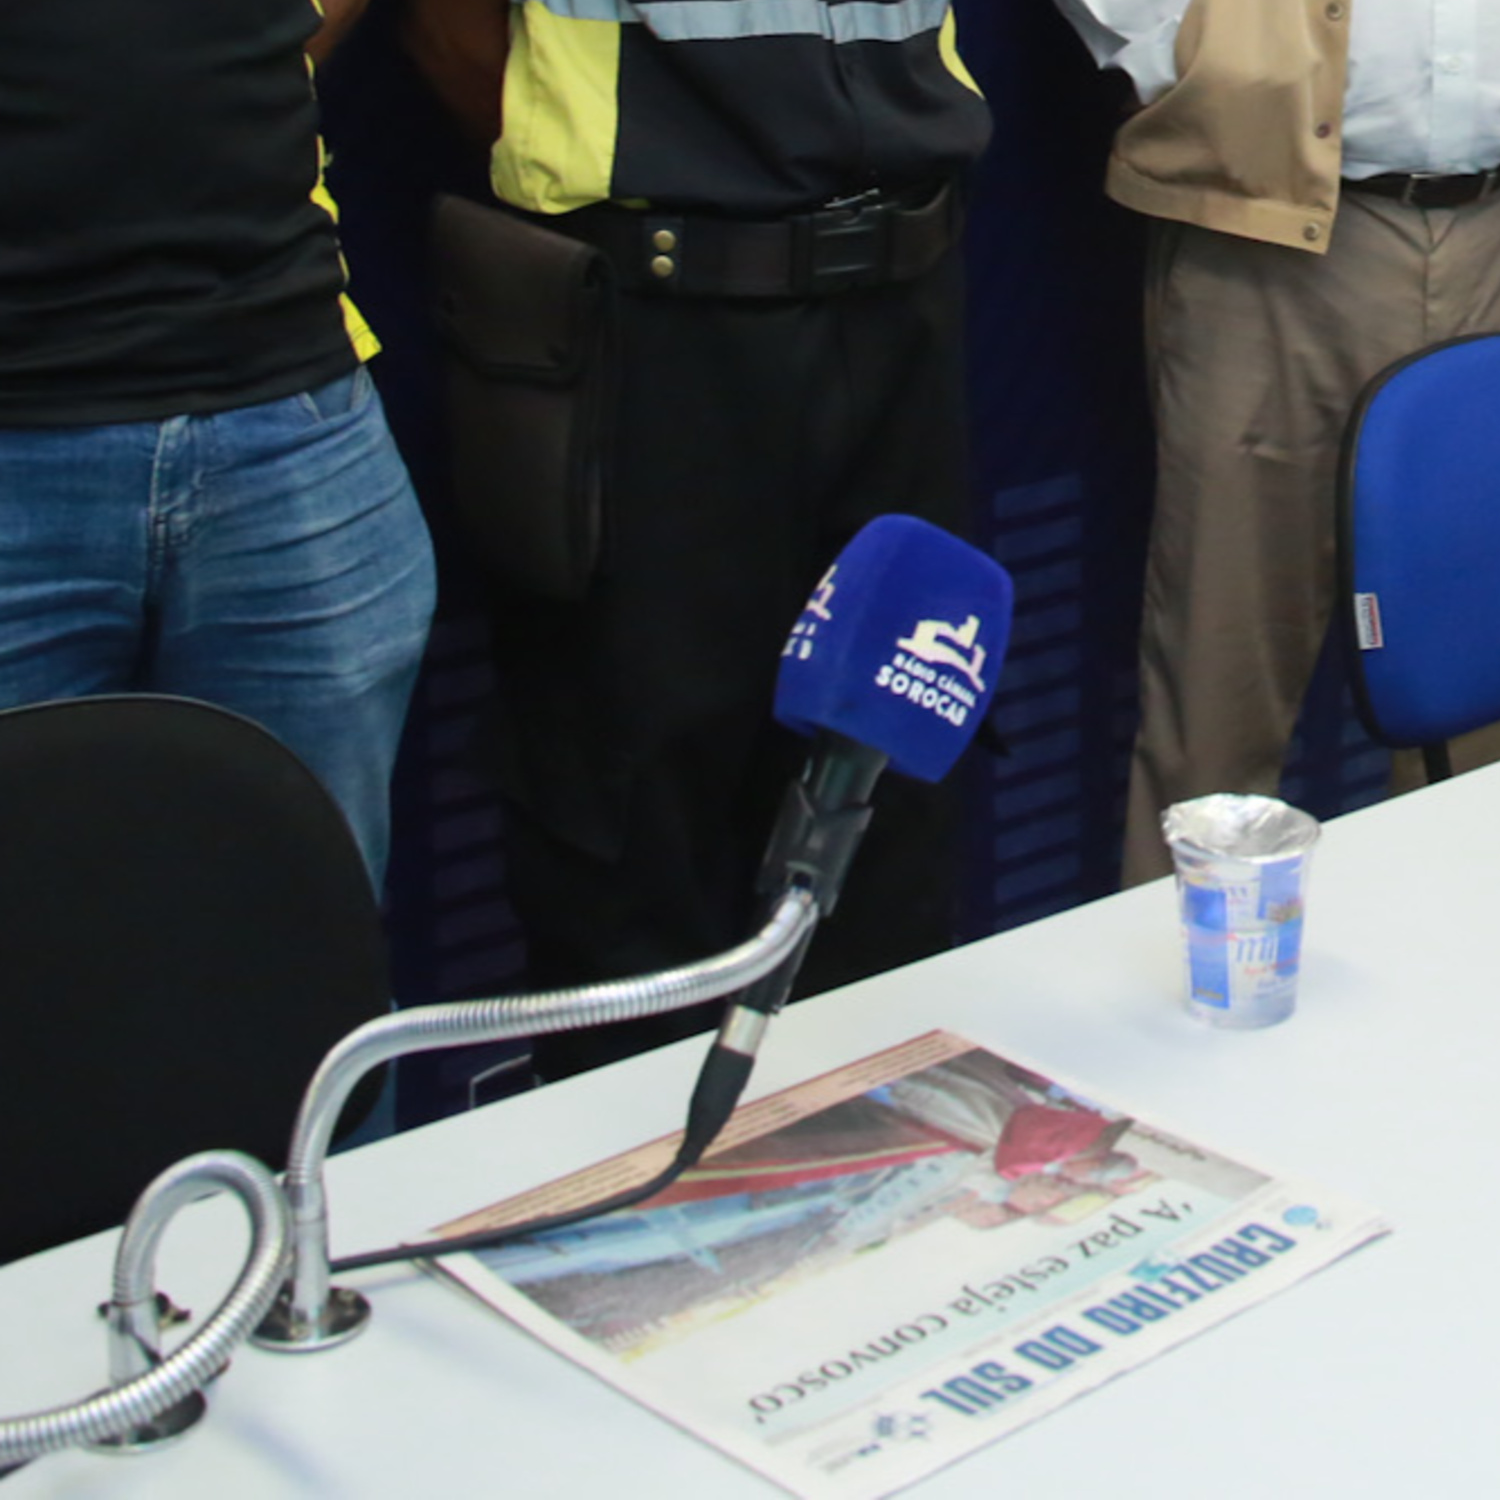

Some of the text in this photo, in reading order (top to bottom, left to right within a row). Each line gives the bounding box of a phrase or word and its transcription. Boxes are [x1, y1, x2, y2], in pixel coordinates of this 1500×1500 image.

[1067, 1214, 1145, 1260] paz
[951, 1254, 1071, 1317] esteja
[1013, 1324, 1104, 1371] DO
[918, 1361, 1034, 1417] SUL
